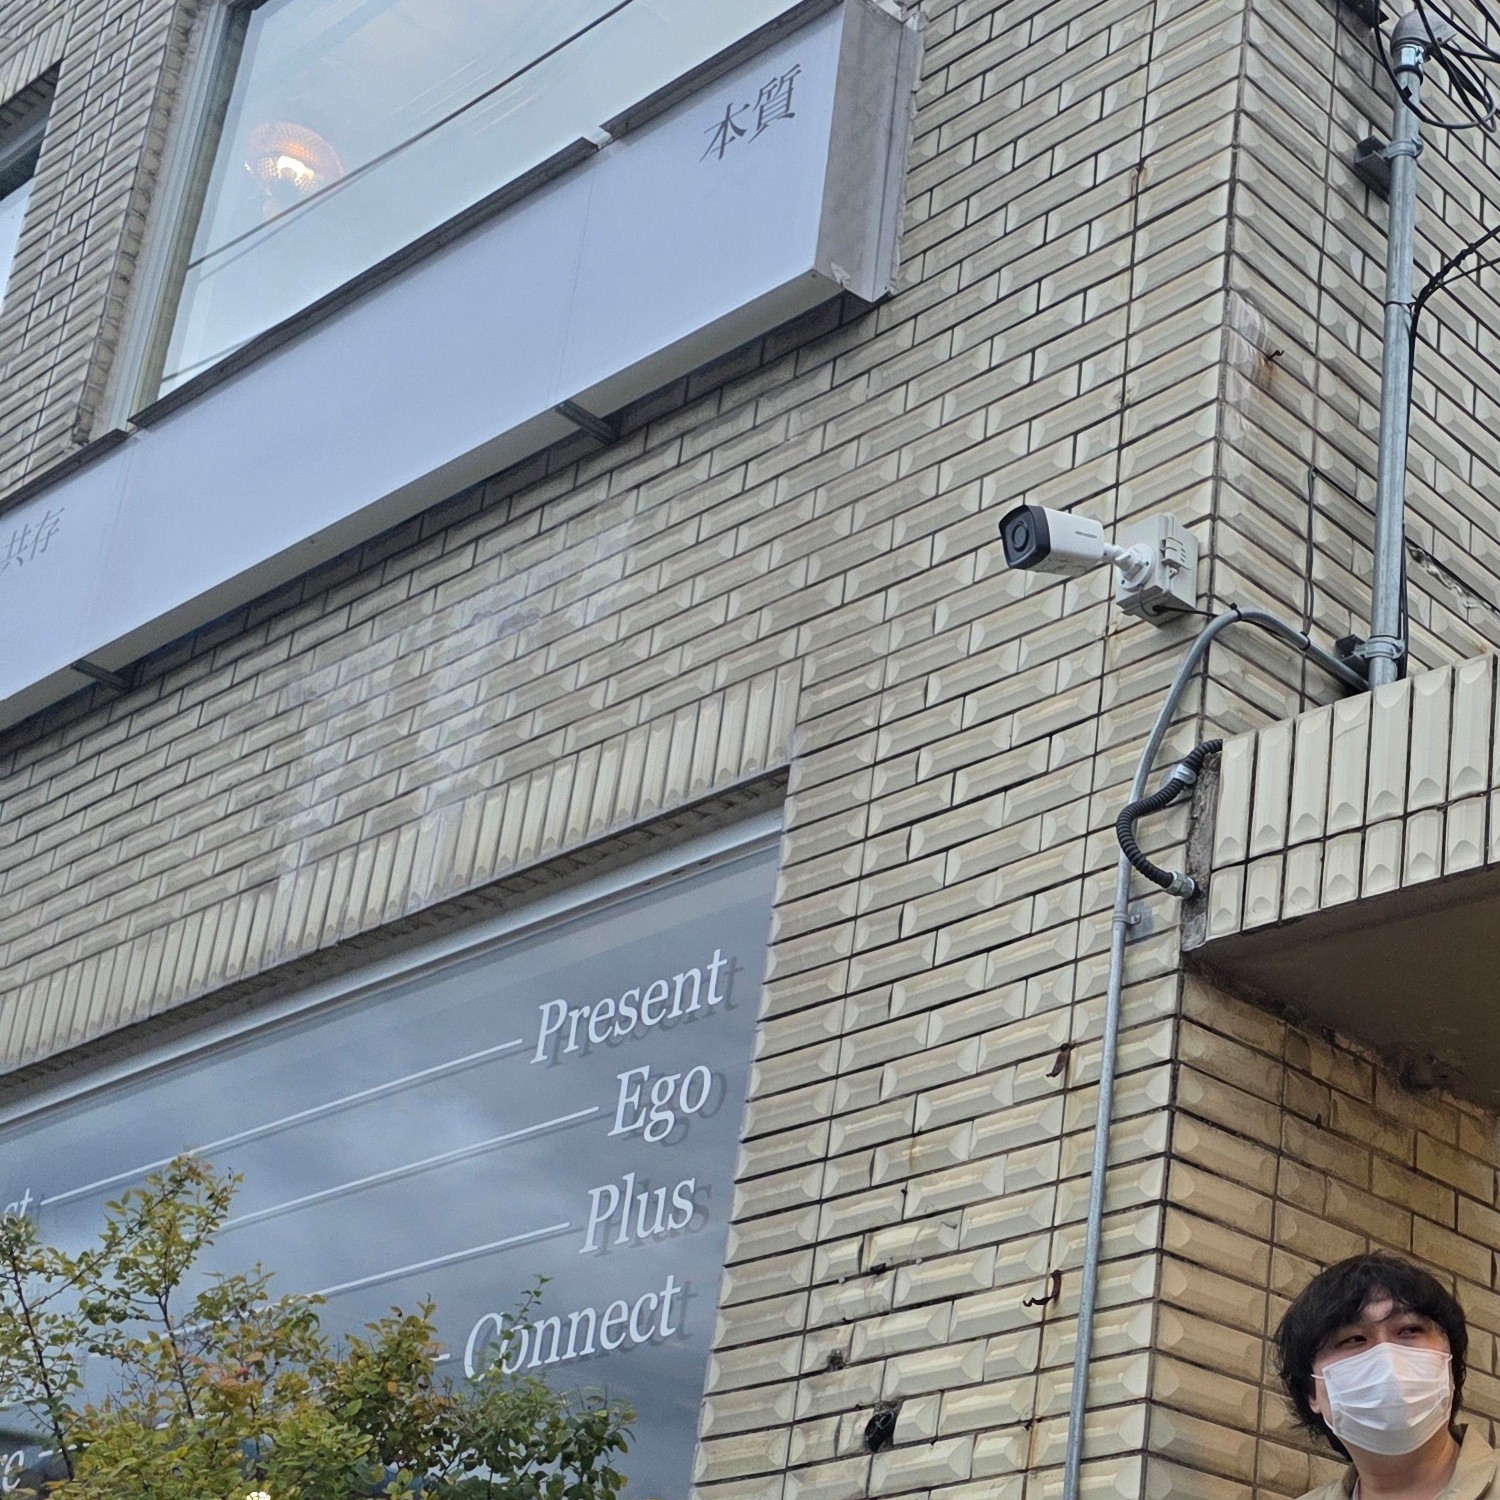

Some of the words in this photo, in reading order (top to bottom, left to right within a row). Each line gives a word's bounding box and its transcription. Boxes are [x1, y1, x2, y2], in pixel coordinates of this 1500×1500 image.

[698, 63, 802, 163] 本質
[529, 948, 728, 1065] Present
[607, 1065, 712, 1142] Ego
[579, 1172, 696, 1254] Plus
[463, 1274, 682, 1381] Connect
